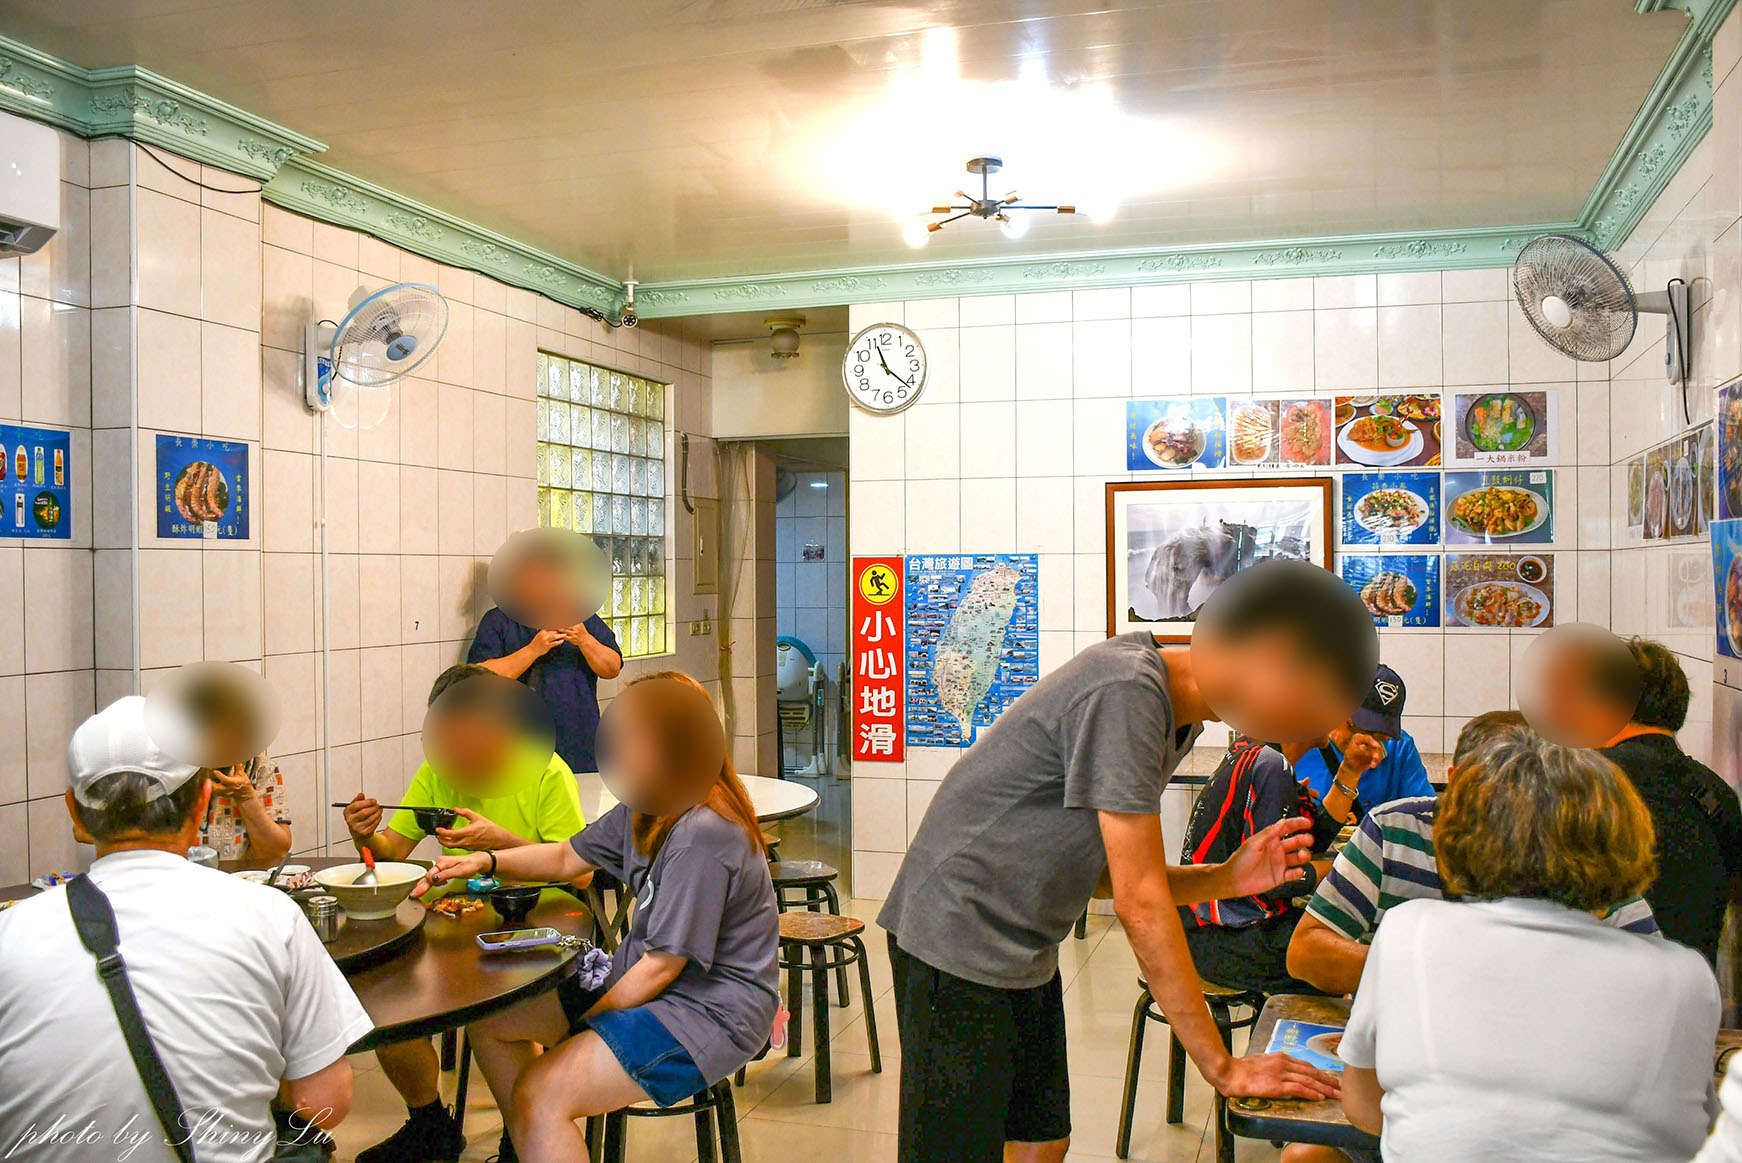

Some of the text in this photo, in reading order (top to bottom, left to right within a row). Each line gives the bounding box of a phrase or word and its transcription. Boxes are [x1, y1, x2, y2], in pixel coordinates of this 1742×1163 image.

[867, 337, 877, 350] 11
[879, 332, 892, 346] 12
[898, 335, 902, 347] 1
[856, 349, 871, 363] 10
[905, 344, 915, 358] 2
[853, 364, 864, 378] 9
[909, 359, 920, 372] 3
[859, 378, 870, 391] 8
[906, 374, 916, 386] 4
[871, 389, 881, 402] 7
[883, 391, 894, 404] 6
[897, 386, 908, 399] 5
[1476, 453, 1527, 464] 一大鍋米粉
[908, 556, 974, 571] 台灣旅遊圖
[414, 620, 420, 631] 7
[859, 610, 897, 756] 小心地滑
